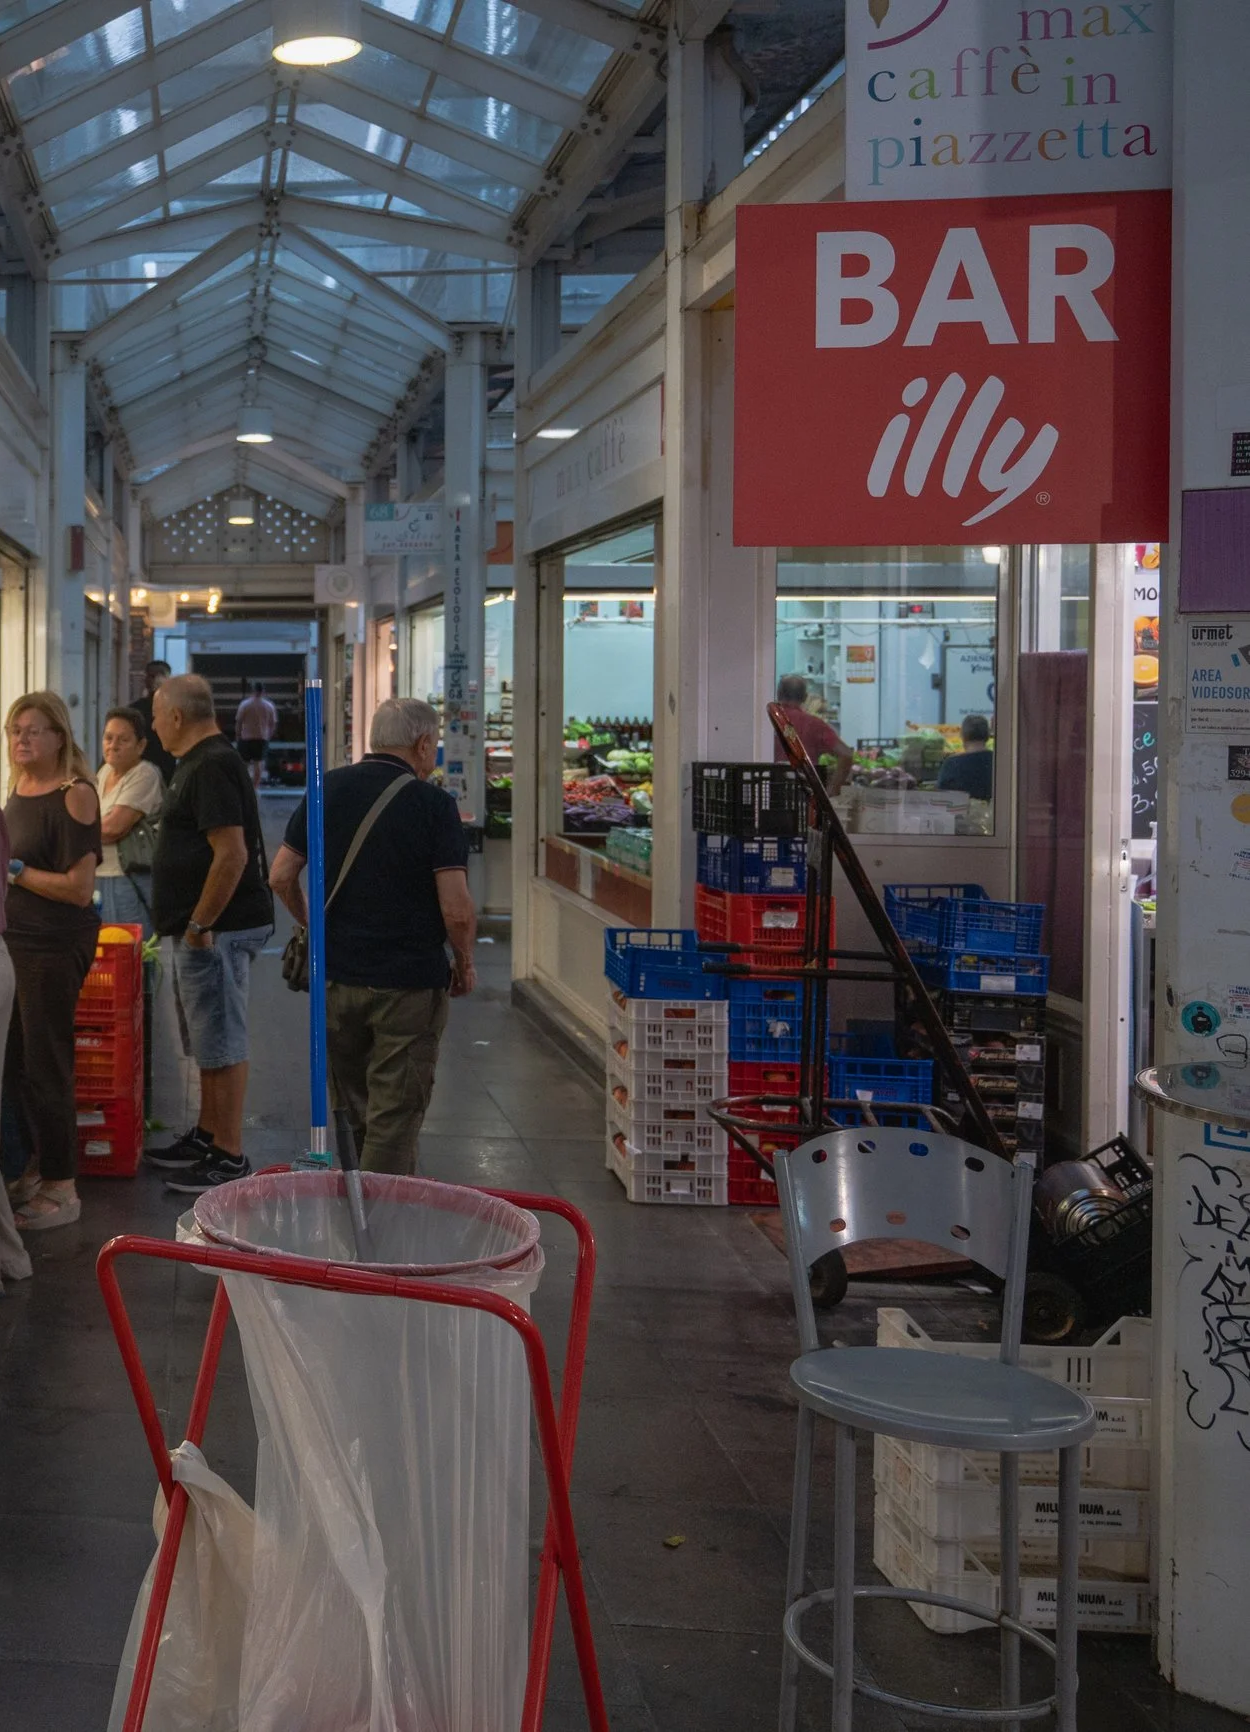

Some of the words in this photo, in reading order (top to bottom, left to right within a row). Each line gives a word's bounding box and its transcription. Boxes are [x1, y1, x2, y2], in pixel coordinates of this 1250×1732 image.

[1018, 3, 1155, 41] max
[867, 46, 1041, 102] caffè
[1061, 57, 1121, 106] in
[867, 118, 1157, 186] piazzetta
[815, 223, 1120, 349] BAR
[867, 372, 1059, 526] illy
[1192, 623, 1233, 640] urmet
[1192, 669, 1222, 682] AREA
